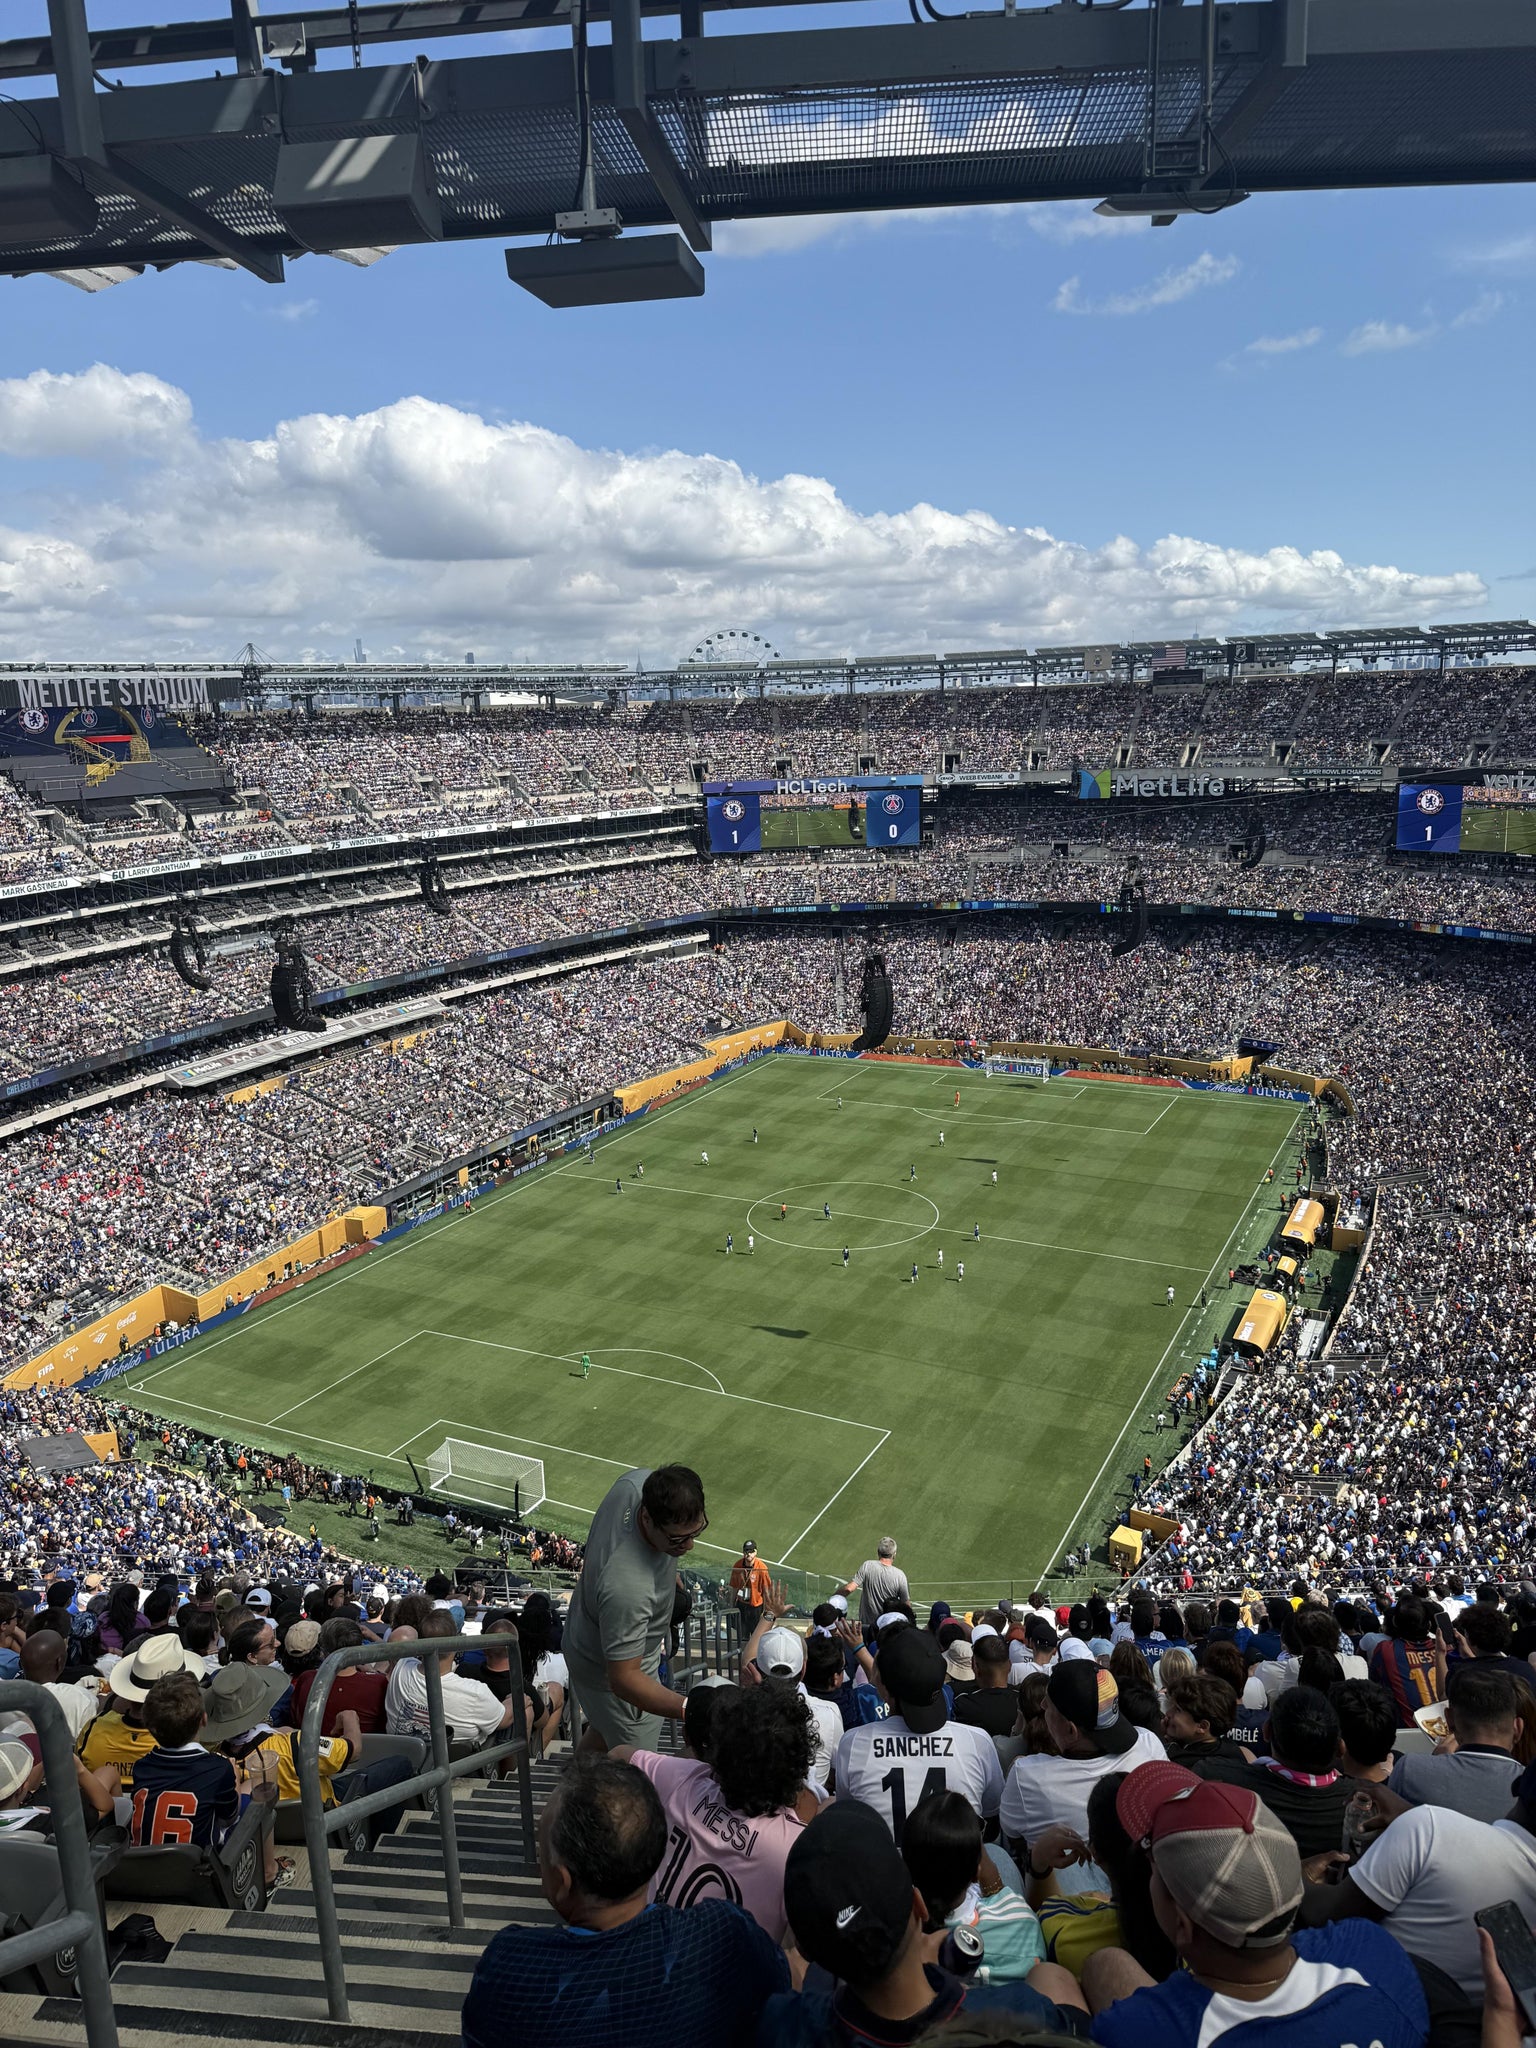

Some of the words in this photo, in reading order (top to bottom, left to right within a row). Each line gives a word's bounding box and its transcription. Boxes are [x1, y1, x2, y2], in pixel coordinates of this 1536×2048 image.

[18, 679, 113, 708] METLIFE
[118, 678, 210, 707] STADIUM
[777, 779, 848, 794] HCLTech
[1115, 772, 1225, 797] MetLife
[1482, 770, 1536, 790] veriz
[426, 830, 436, 838] 73
[731, 830, 738, 844] 1
[889, 824, 897, 838] 0
[1425, 825, 1432, 841] 1
[330, 841, 341, 849] 75
[349, 837, 376, 847] WINSTON
[260, 849, 277, 858] LEON
[277, 847, 293, 856] HESS
[111, 871, 126, 880] 60
[128, 867, 150, 877] LARRY
[151, 862, 191, 873] GRANTHAM
[2, 886, 26, 897] MARK
[26, 879, 68, 892] GASTINEAU
[281, 1032, 315, 1047] METLIFE
[747, 1050, 764, 1063] ULTRA
[818, 1050, 848, 1058] ULTRA
[194, 1061, 223, 1075] MetLife
[1205, 1083, 1246, 1094] Michelob
[1256, 1087, 1294, 1100] ULTRA
[604, 1116, 626, 1133] ULTRA
[450, 1188, 481, 1208] ULTRA
[93, 1351, 142, 1388] Michelob
[154, 1325, 201, 1355] ULTRA
[37, 1363, 55, 1379] FIFA
[1220, 1727, 1258, 1743] MBÉLÉ
[873, 1736, 954, 1758] SANCHEZ
[131, 1788, 198, 1847] 16
[692, 1794, 760, 1858] MESSI
[653, 1825, 744, 1911] 10
[838, 1905, 854, 1921] NIKE
